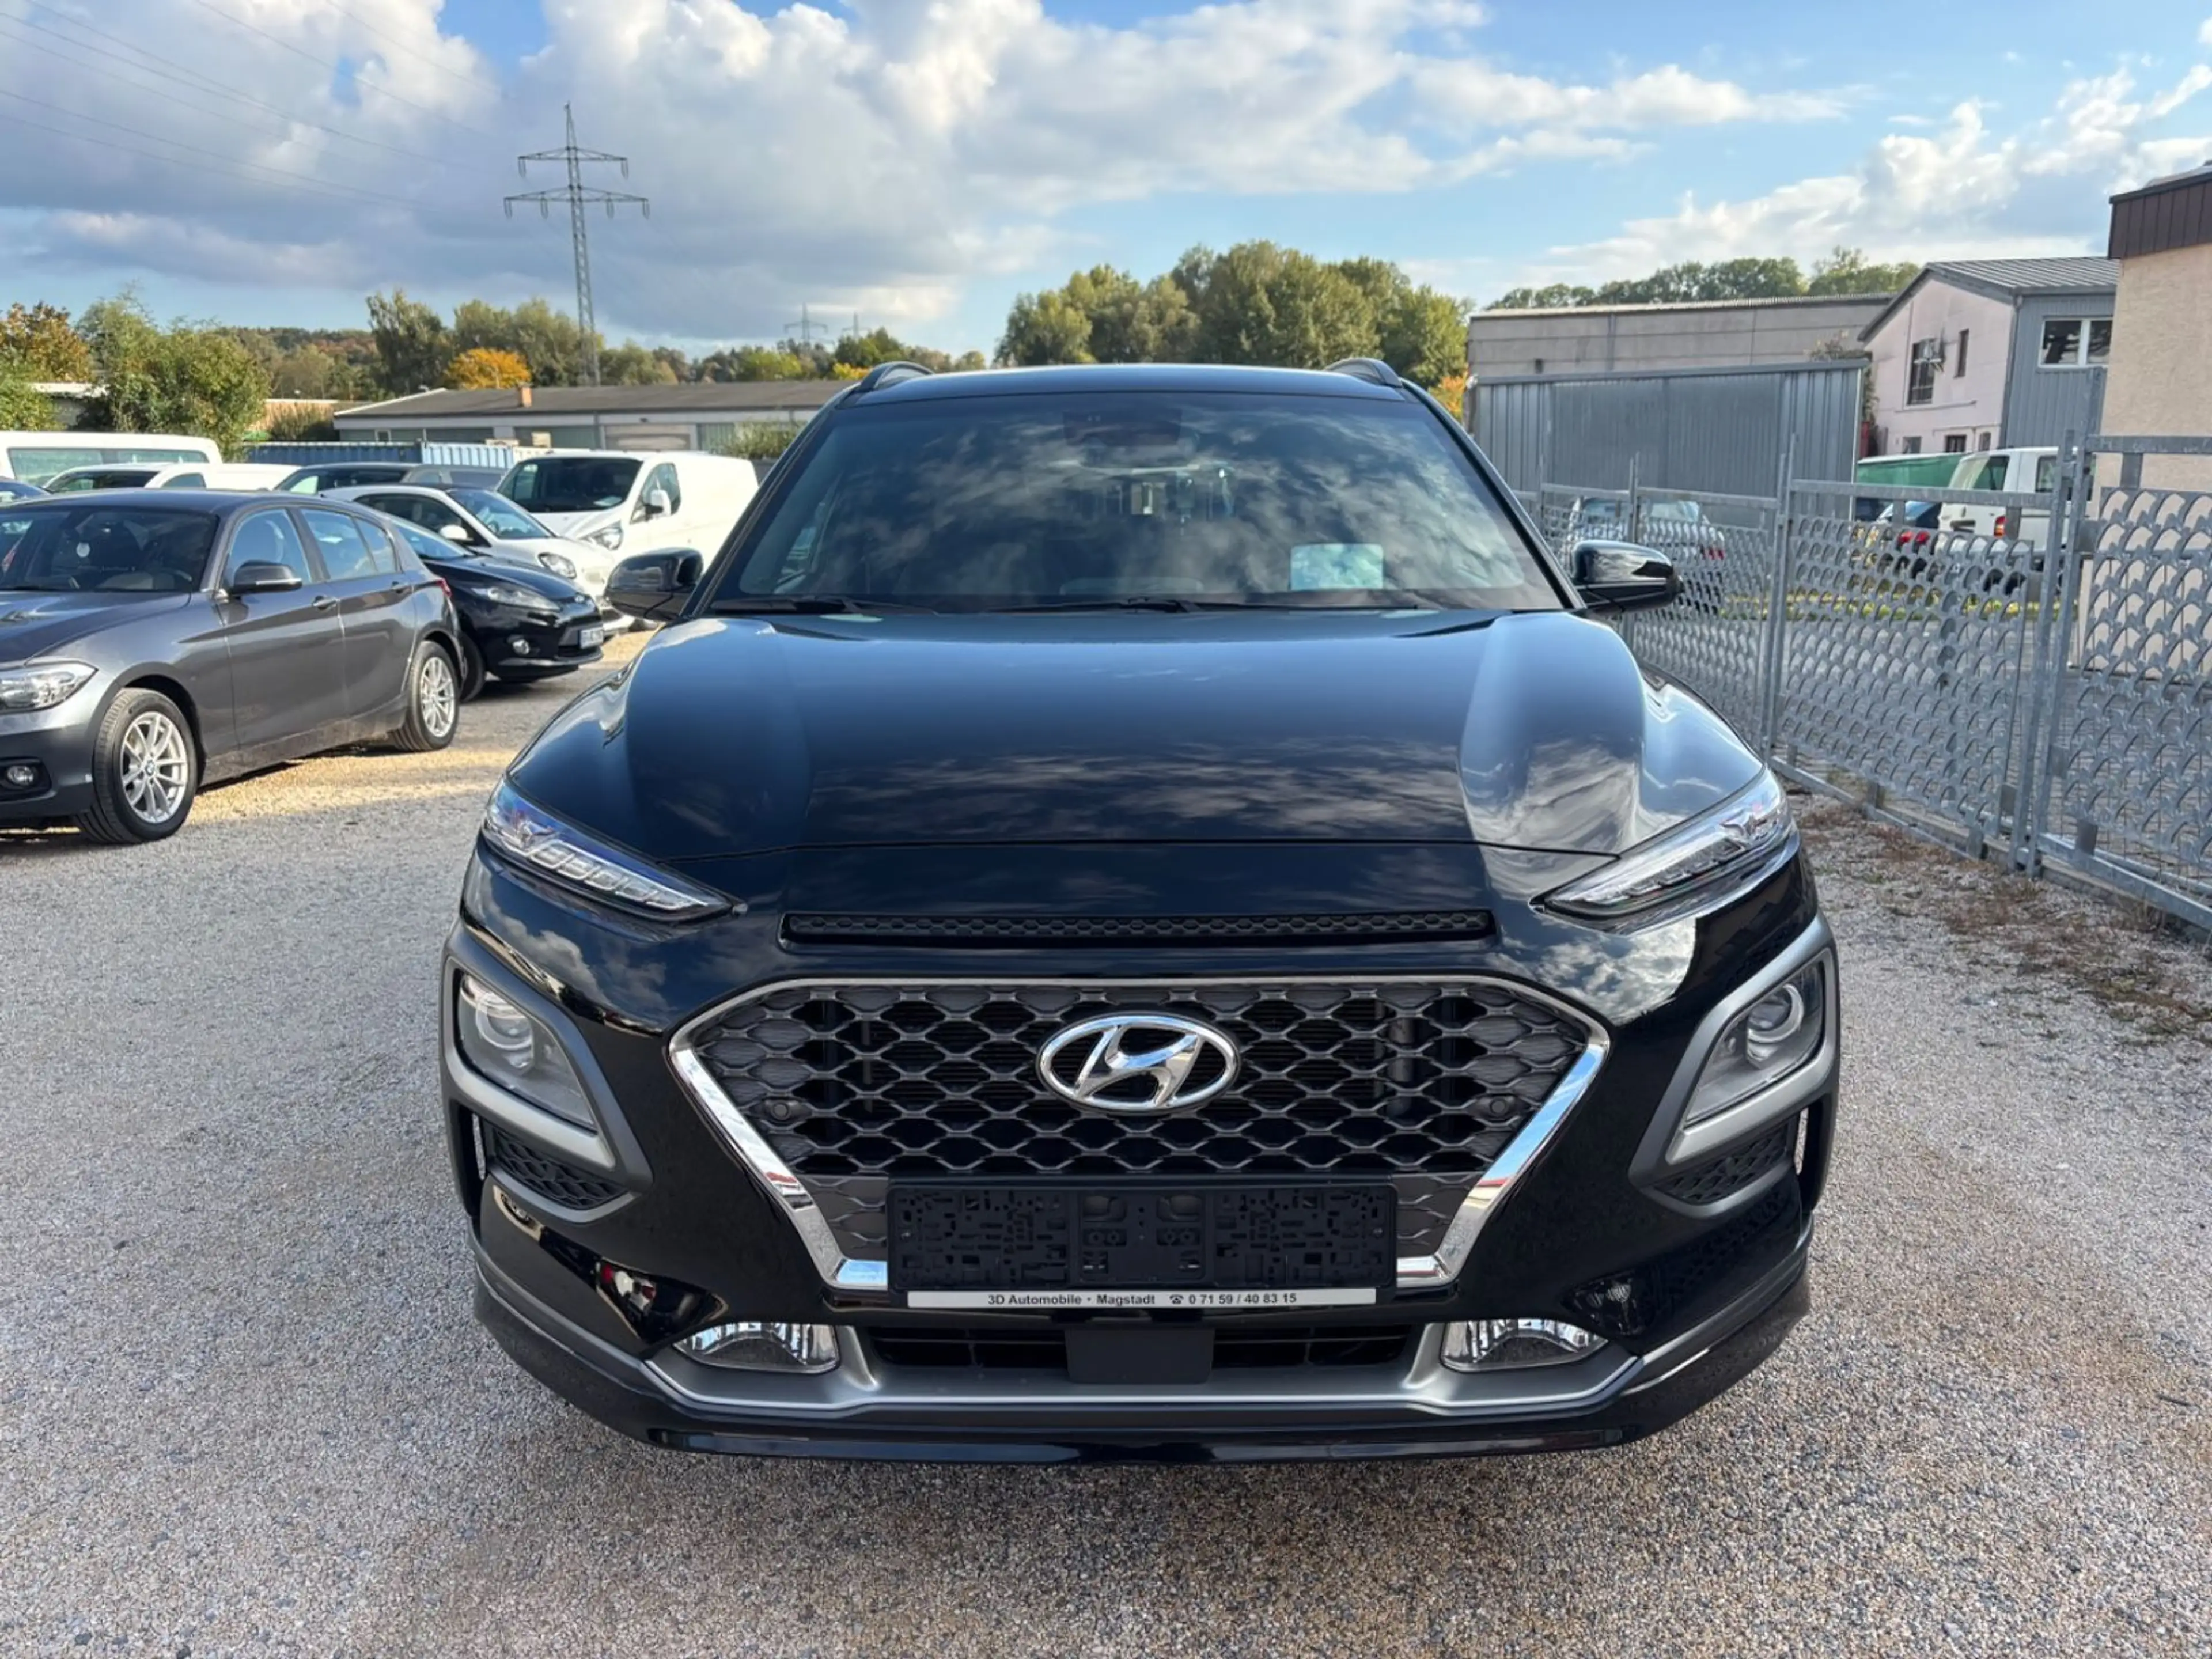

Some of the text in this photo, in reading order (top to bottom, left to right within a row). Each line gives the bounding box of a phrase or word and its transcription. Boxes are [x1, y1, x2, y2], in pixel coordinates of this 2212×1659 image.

[988, 1295, 1005, 1305] 3D
[1008, 1294, 1081, 1305] Automobile
[1096, 1294, 1156, 1306] Magstadt
[1188, 1294, 1196, 1304] 0
[1200, 1294, 1214, 1304] 71
[1219, 1294, 1233, 1304] 59
[1244, 1294, 1260, 1304] 40
[1263, 1293, 1278, 1304] 83
[1283, 1293, 1297, 1303] 15
